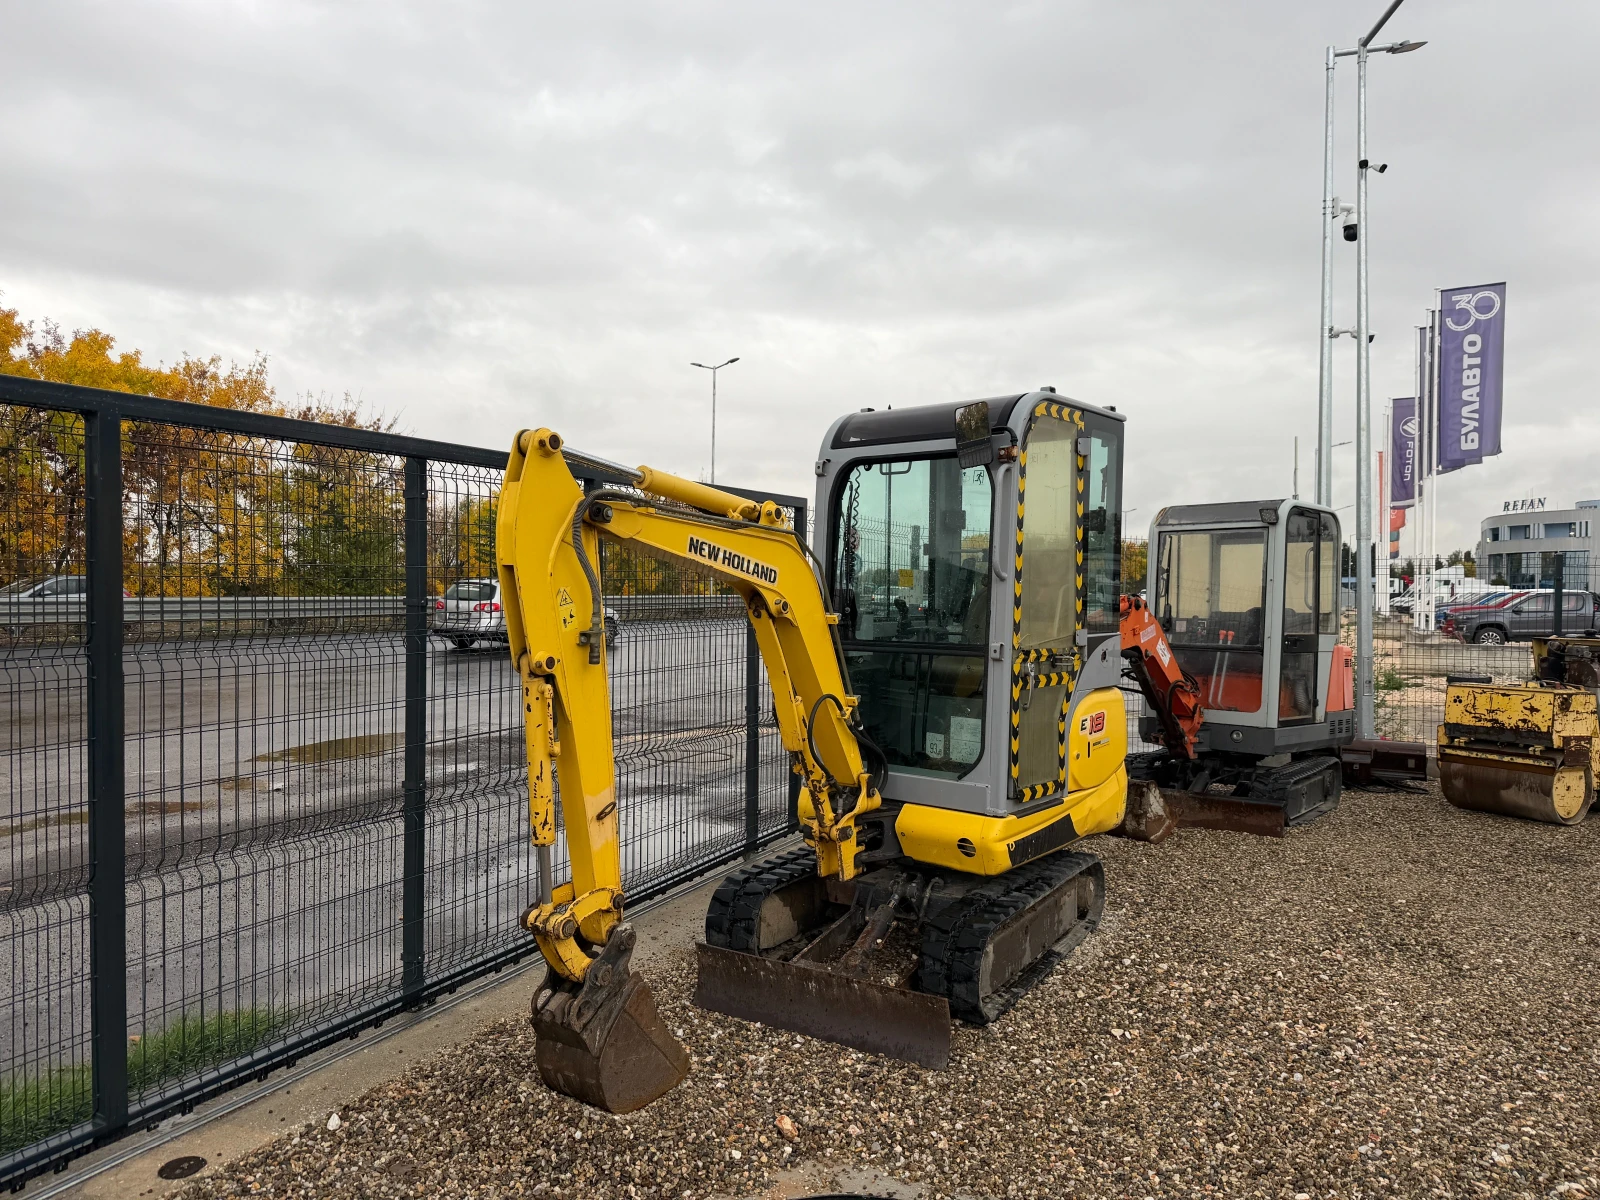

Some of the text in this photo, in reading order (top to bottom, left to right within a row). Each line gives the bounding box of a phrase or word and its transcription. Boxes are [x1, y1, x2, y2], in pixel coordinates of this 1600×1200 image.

[1460, 333, 1482, 451] БУЛАВТО
[1502, 497, 1547, 512] REFAN
[688, 536, 778, 584] NEW HOLLAND
